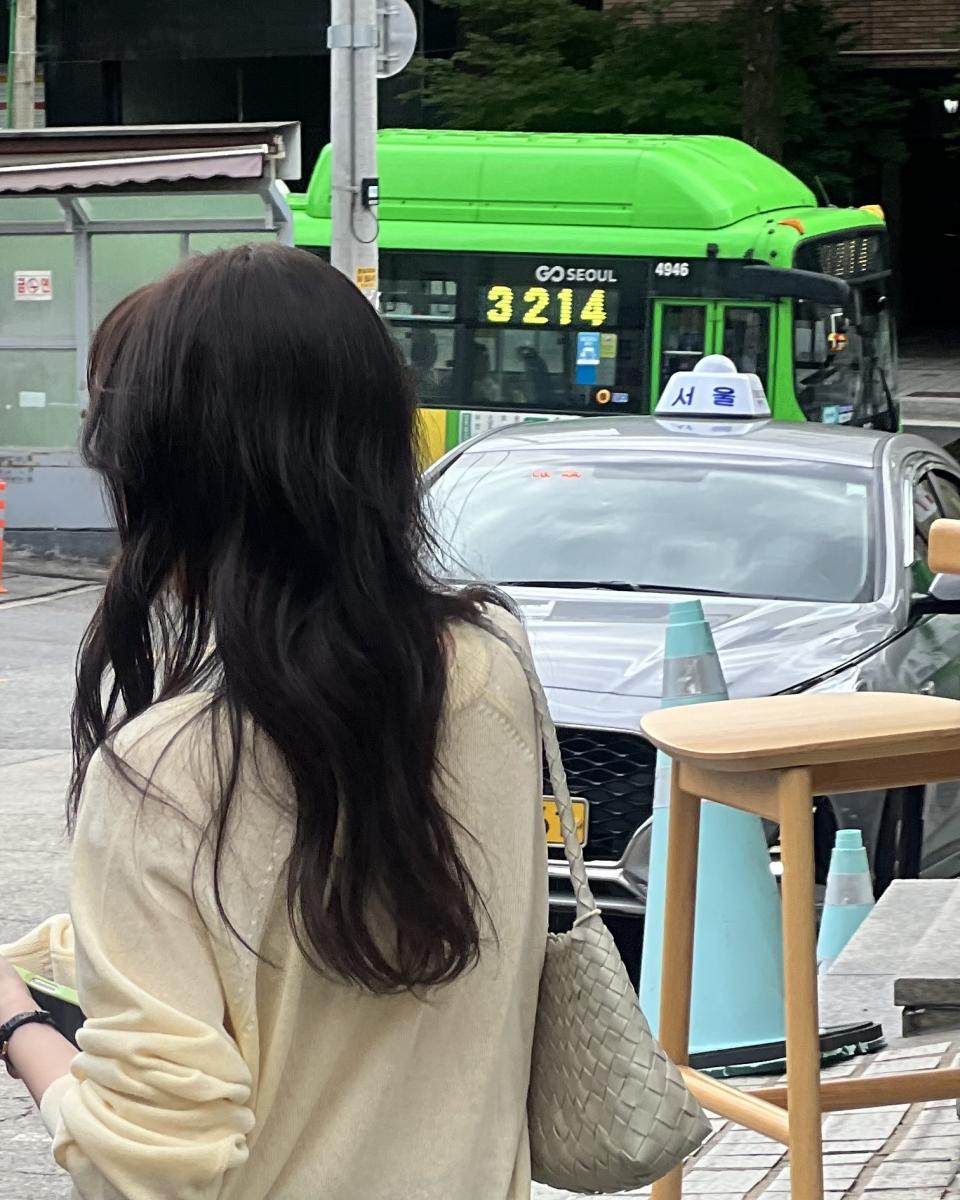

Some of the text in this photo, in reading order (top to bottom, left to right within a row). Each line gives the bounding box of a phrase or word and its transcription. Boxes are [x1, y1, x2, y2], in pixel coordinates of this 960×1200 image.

[566, 268, 618, 283] SEOUL
[655, 262, 690, 277] 4946
[487, 285, 607, 327] 3214
[672, 386, 736, 407] 서울
